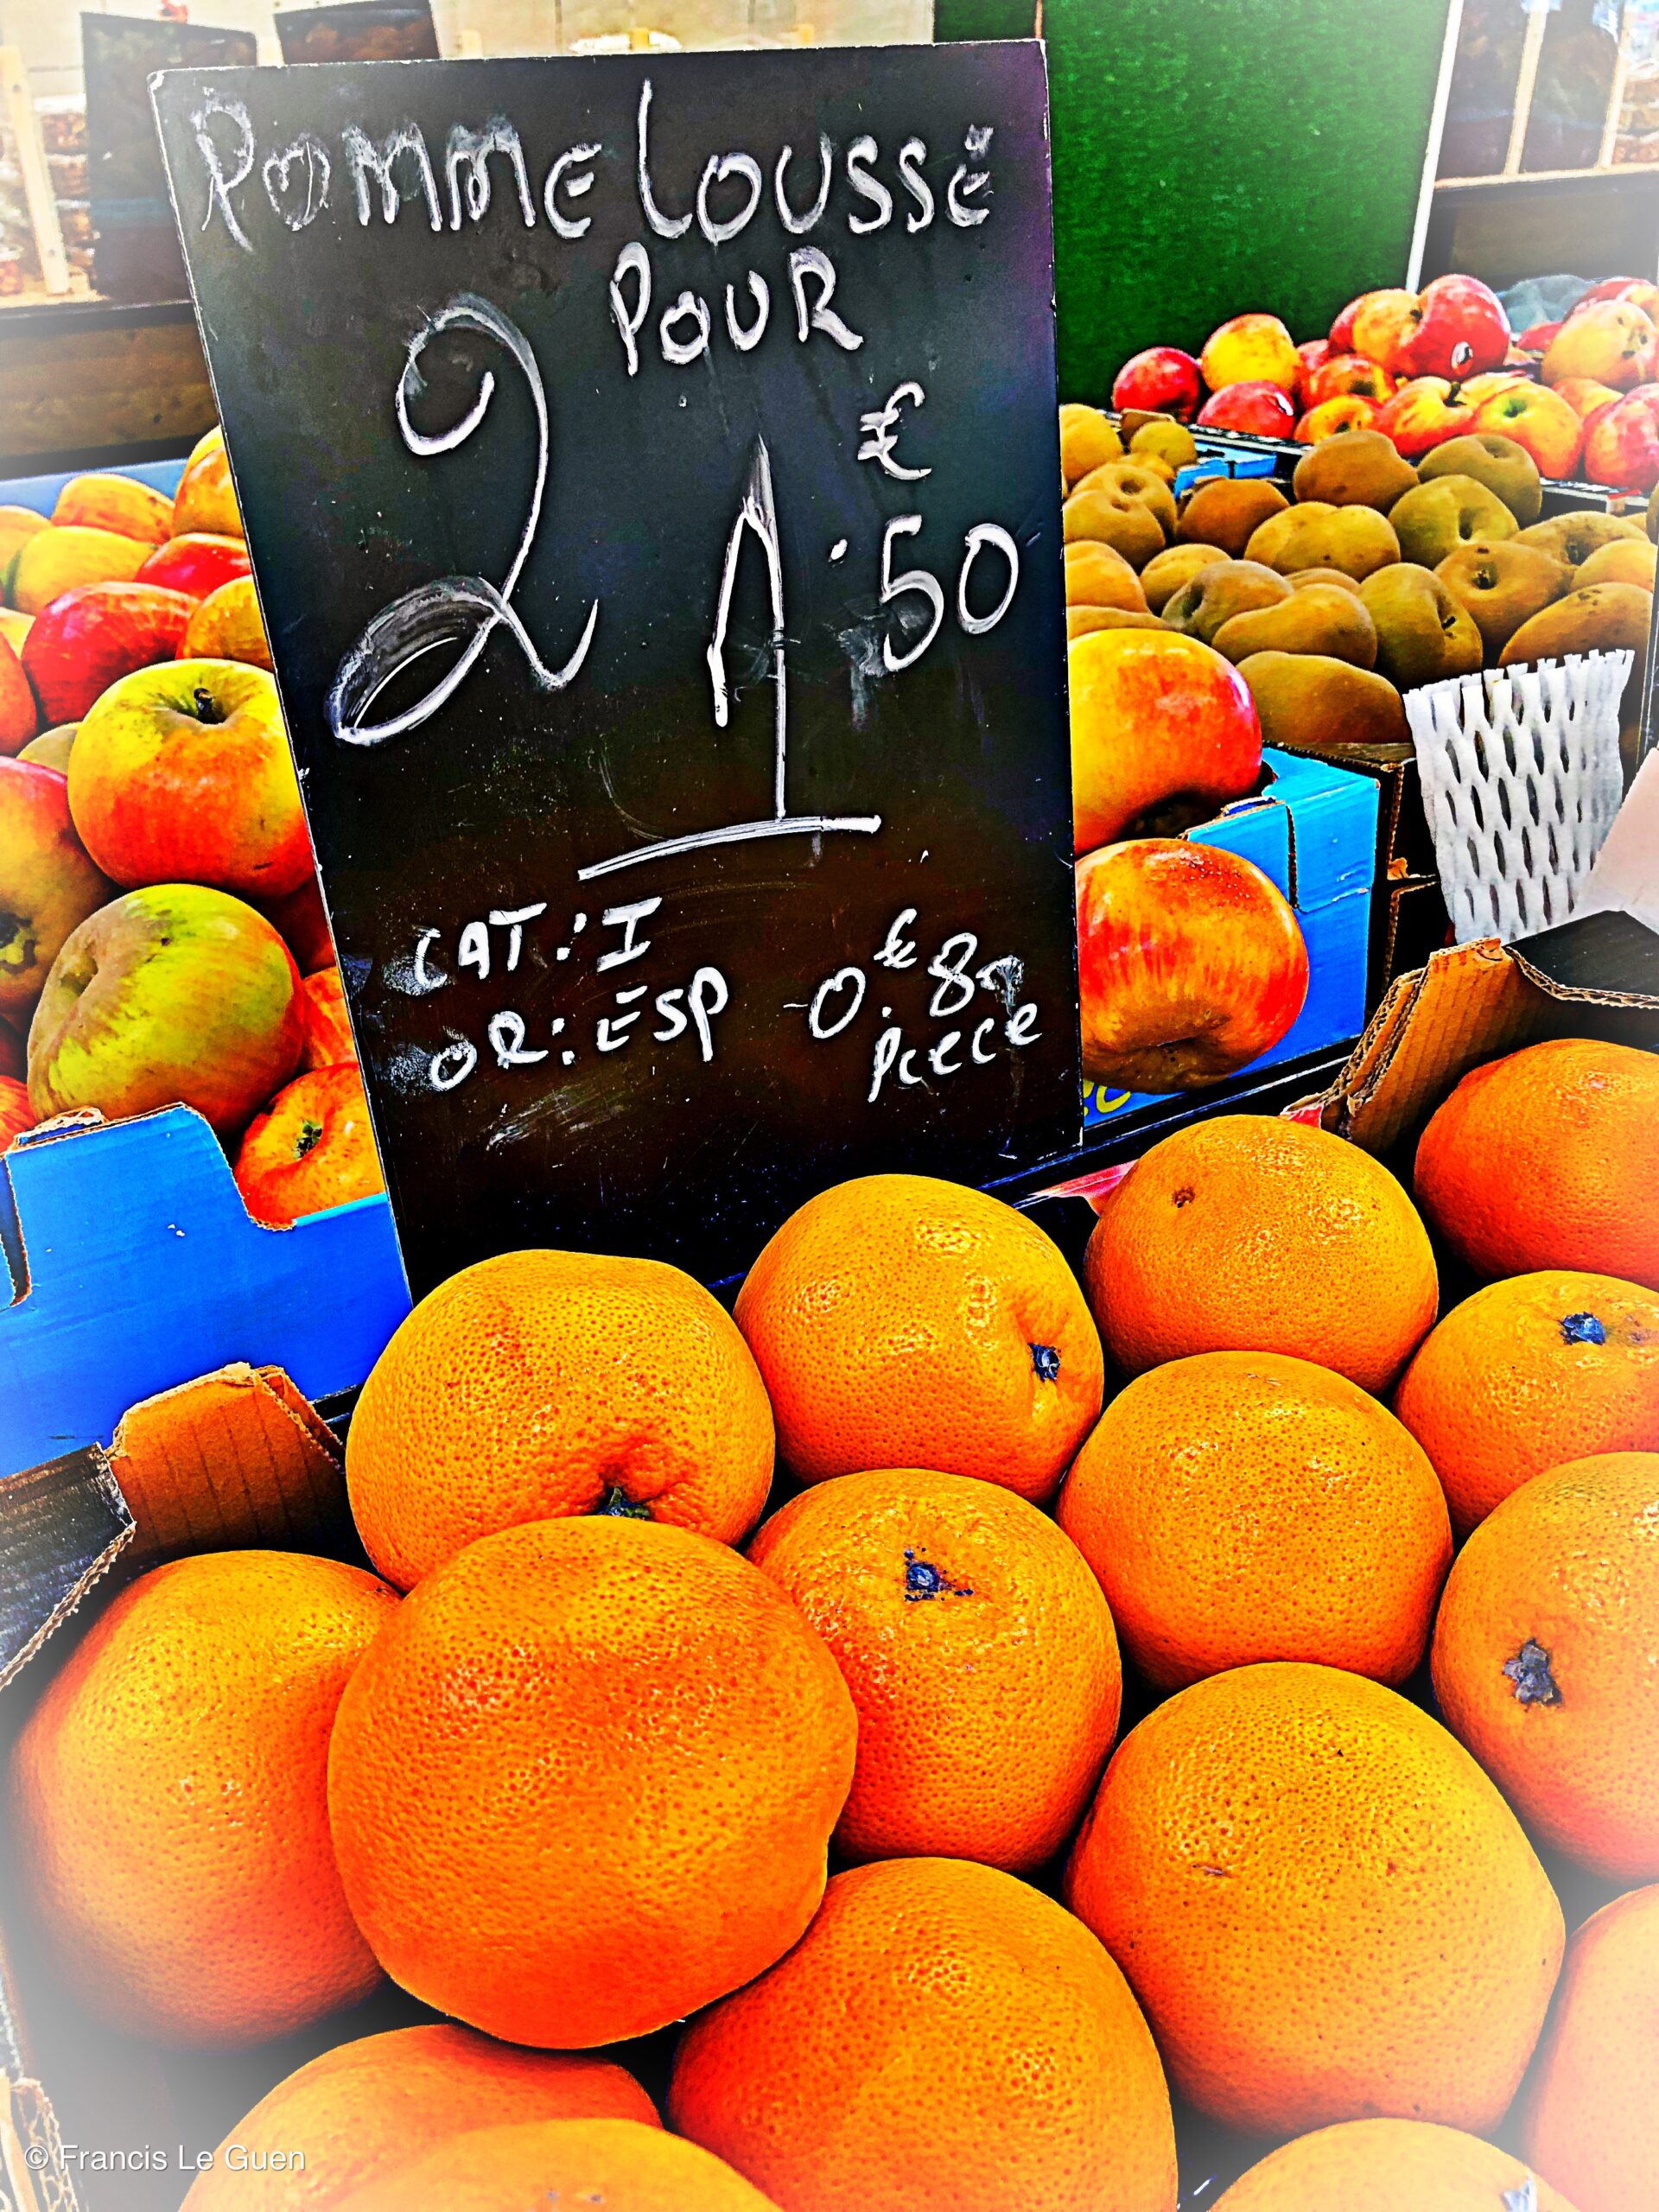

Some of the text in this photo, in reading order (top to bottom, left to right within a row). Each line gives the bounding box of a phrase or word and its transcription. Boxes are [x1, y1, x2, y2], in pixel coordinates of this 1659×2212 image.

[609, 241, 864, 376] POUR
[856, 380, 932, 480] €
[323, 292, 600, 747] 2
